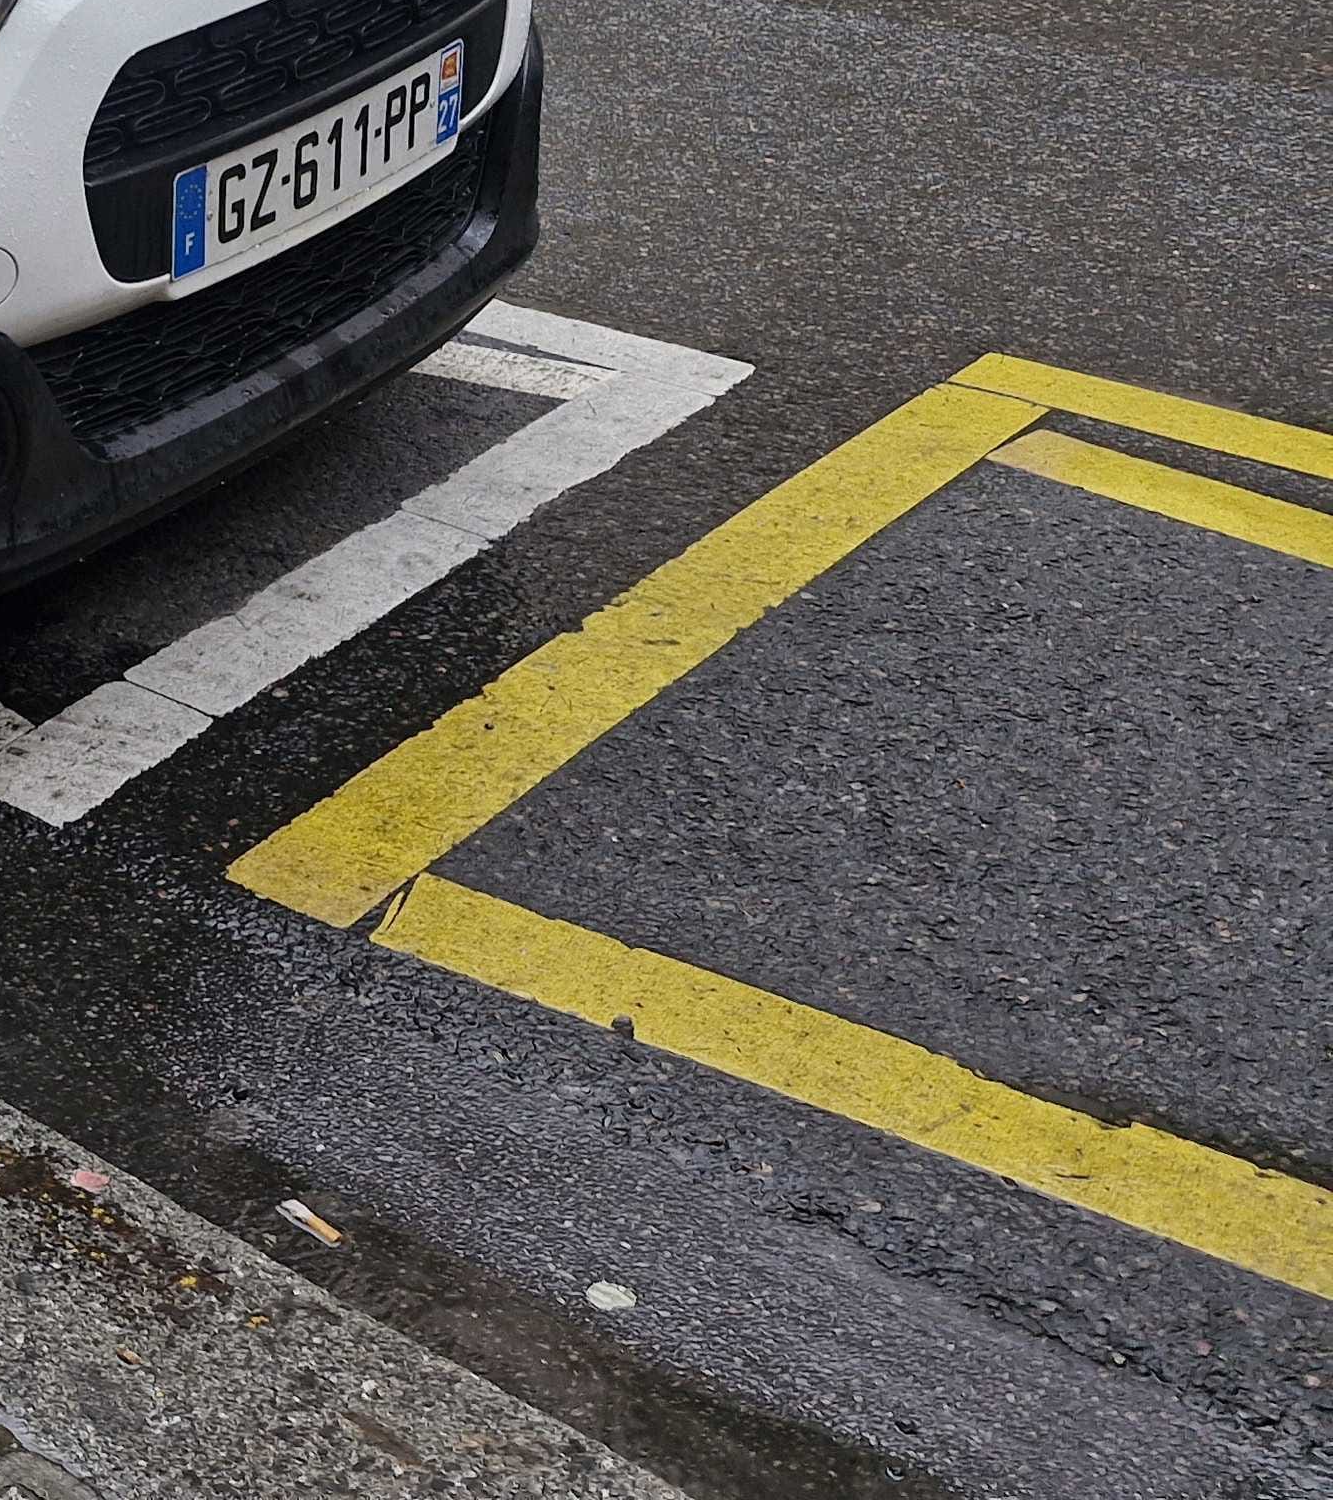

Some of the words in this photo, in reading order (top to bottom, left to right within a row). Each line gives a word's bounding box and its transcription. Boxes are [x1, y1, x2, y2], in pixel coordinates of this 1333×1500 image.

[438, 92, 459, 132] 27
[217, 71, 431, 244] GZ-611-PP
[185, 231, 195, 256] F
